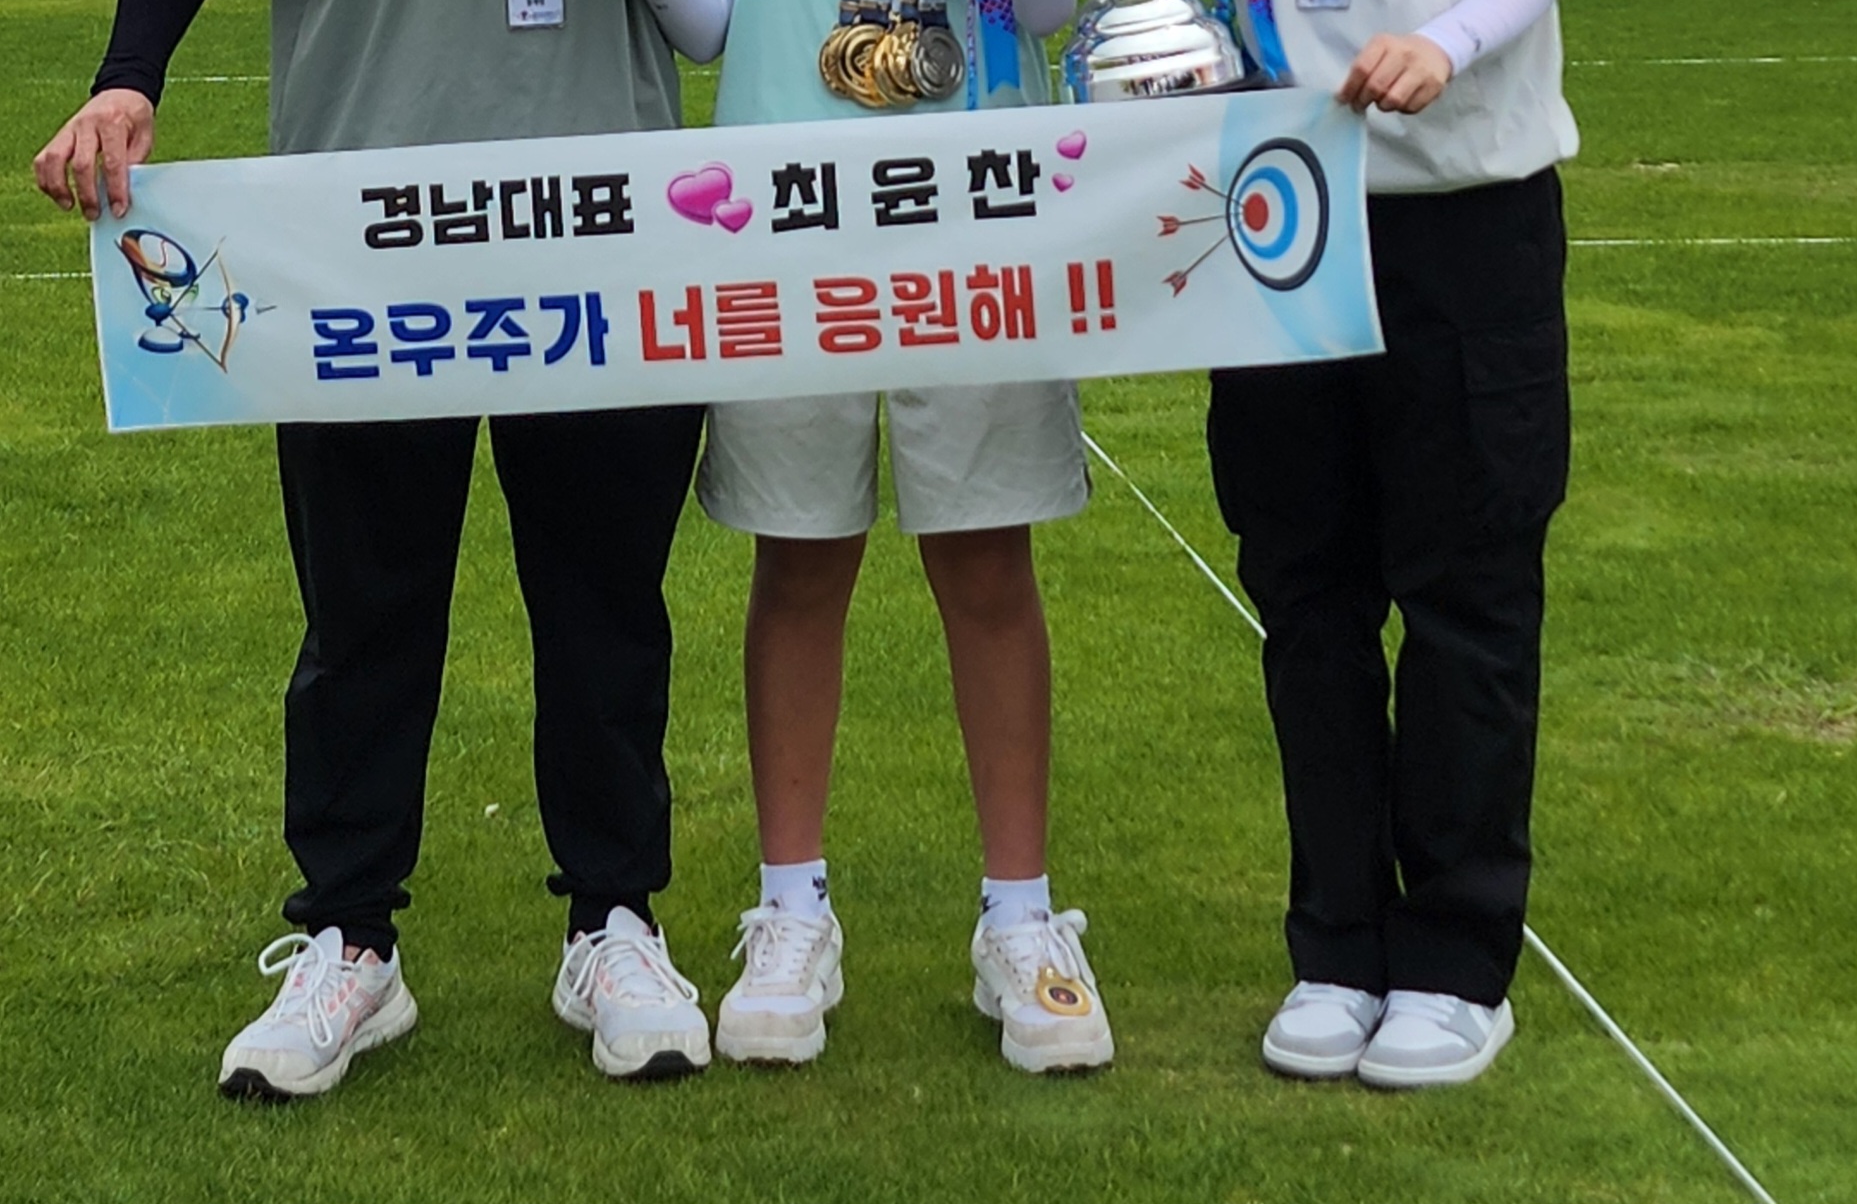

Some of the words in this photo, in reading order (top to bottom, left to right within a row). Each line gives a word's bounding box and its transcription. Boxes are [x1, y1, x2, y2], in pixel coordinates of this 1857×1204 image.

[360, 173, 635, 250] 경남대표
[771, 161, 840, 233] 최
[871, 156, 939, 227] 윤
[966, 148, 1041, 220] 찬
[310, 292, 610, 380] 온우주가
[638, 280, 784, 361] 너를
[813, 264, 1037, 353] 응원해
[1067, 259, 1118, 334] !!
